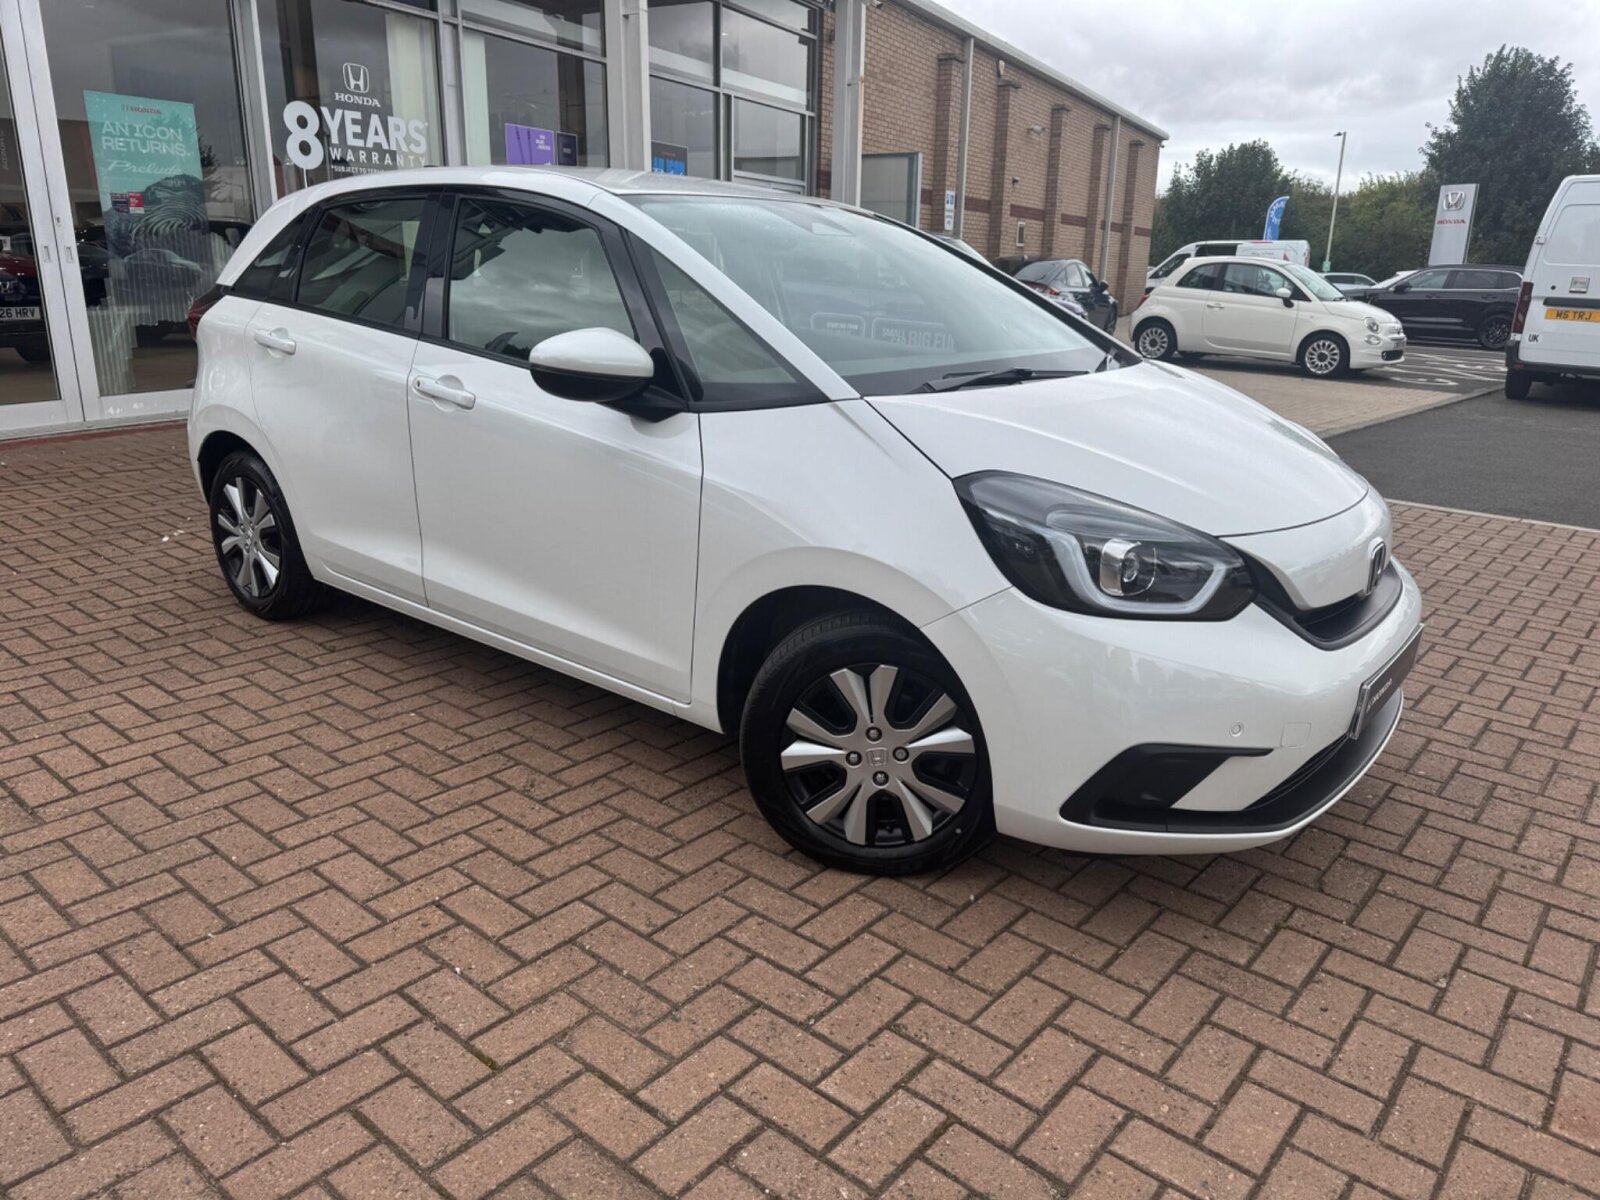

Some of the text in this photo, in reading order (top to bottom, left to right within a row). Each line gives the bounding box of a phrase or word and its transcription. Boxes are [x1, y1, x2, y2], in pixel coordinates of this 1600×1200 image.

[335, 92, 382, 107] HONDA
[102, 120, 183, 142] AN ICON
[283, 100, 324, 170] 8
[329, 146, 427, 168] WARRANTY
[105, 160, 182, 175] Prelude
[15, 308, 36, 318] HRV
[1528, 333, 1539, 342] UK
